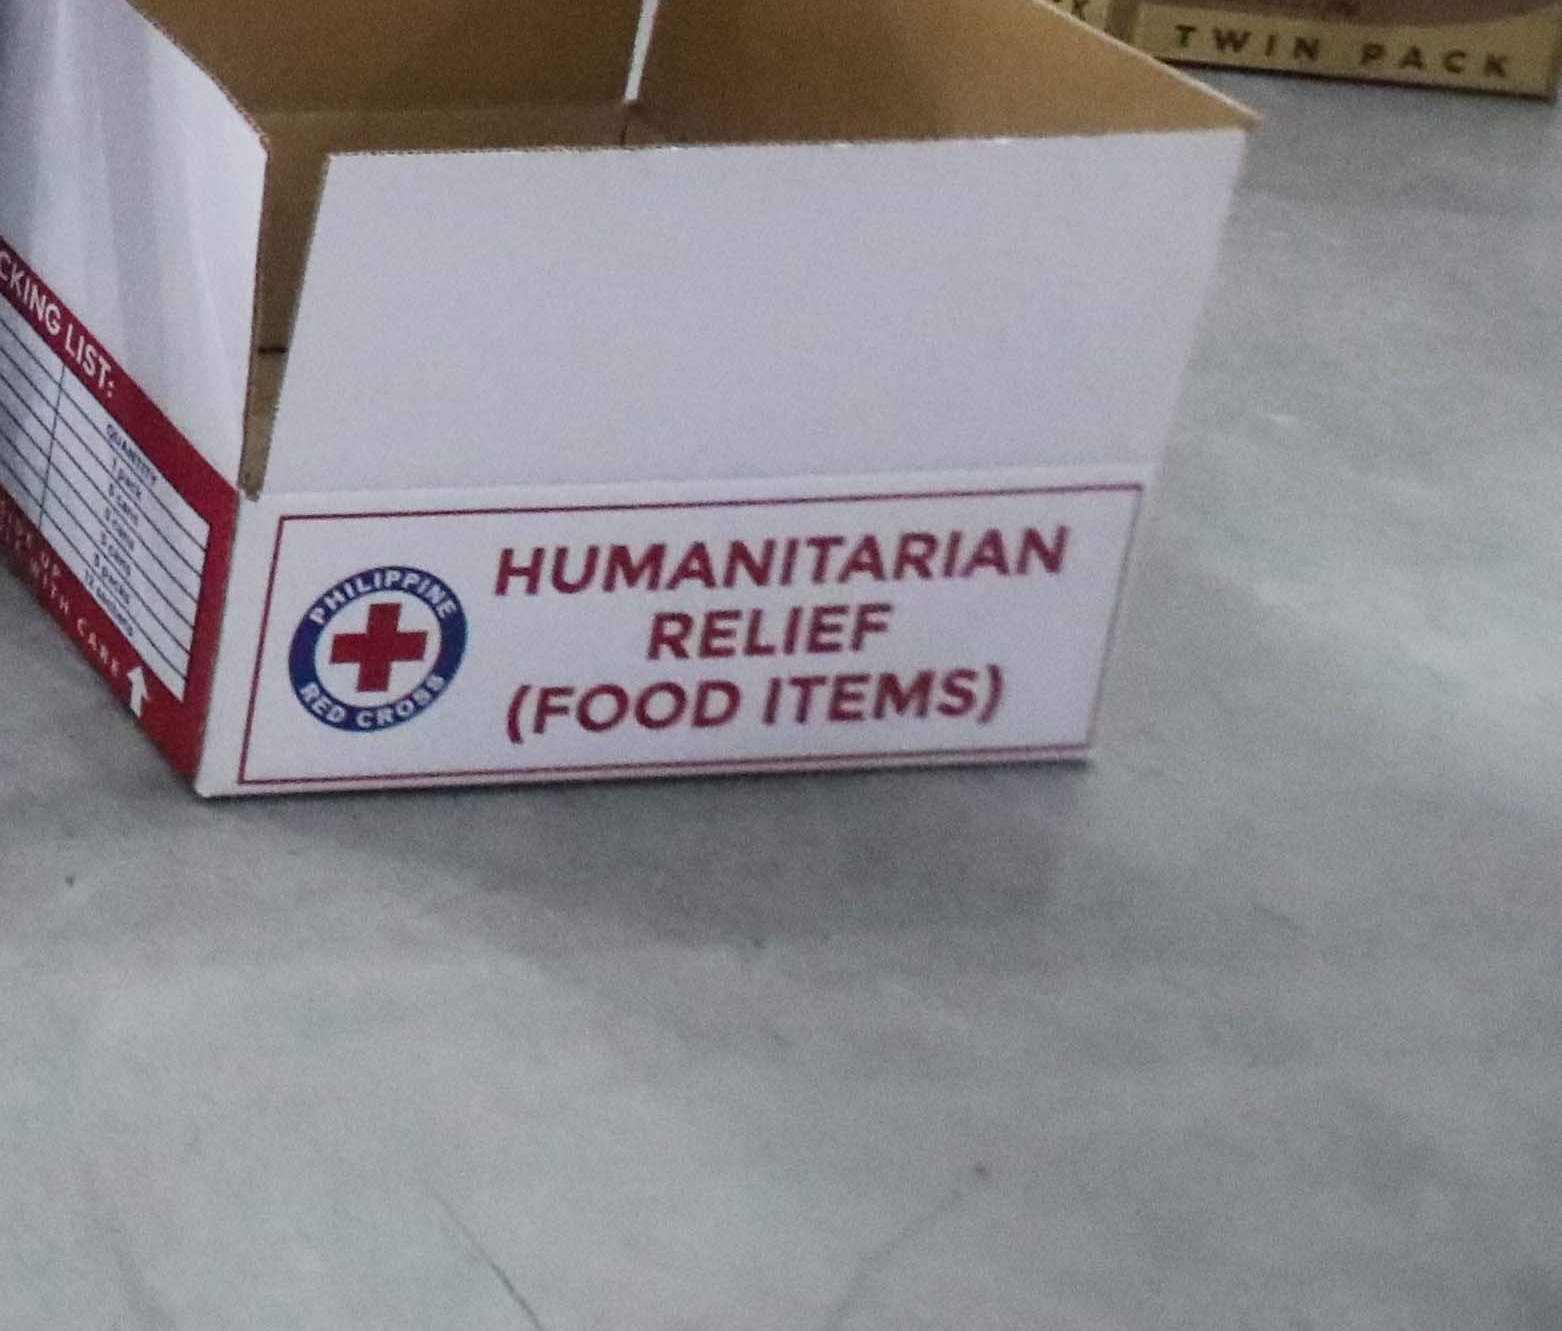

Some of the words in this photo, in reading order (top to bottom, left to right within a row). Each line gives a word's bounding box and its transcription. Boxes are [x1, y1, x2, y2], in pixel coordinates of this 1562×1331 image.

[1173, 23, 1320, 65] TWIN
[1359, 42, 1510, 79] PACK
[64, 332, 116, 399] LIST:
[492, 523, 1071, 598] HUMANITARIAN
[308, 569, 458, 626] PHILIPPINE
[75, 617, 121, 676] CARE
[645, 602, 894, 662] RELIEF
[299, 682, 347, 724] RED
[355, 675, 446, 728] CROSS
[504, 680, 741, 746] (FOOD
[760, 663, 1006, 728] ITEMS)
